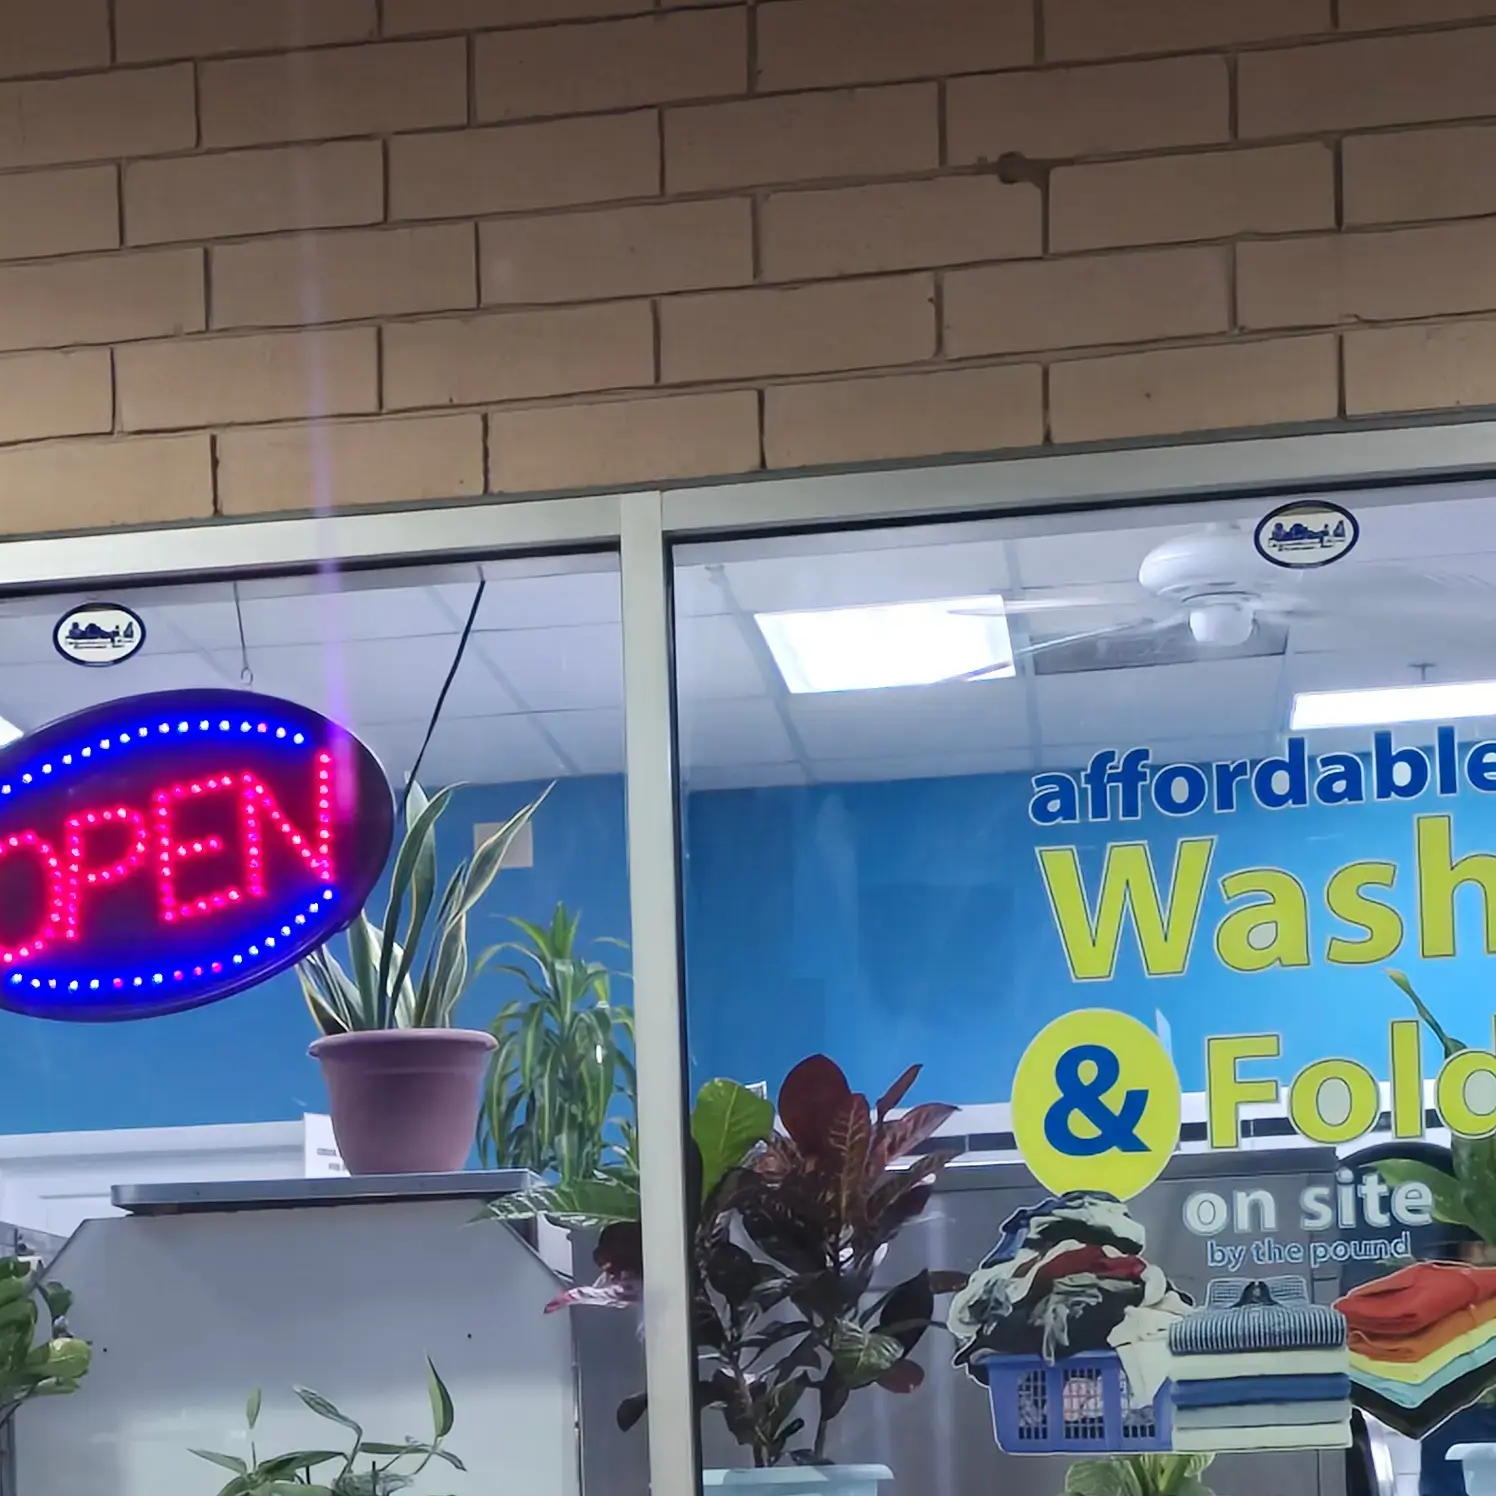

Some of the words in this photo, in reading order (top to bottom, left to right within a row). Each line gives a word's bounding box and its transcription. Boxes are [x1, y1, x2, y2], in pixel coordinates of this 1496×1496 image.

[1029, 725, 1496, 826] affordable
[1035, 813, 1496, 982] Wash
[1044, 1043, 1152, 1157] &
[1183, 1189, 1278, 1236] on
[1300, 1166, 1435, 1231] site
[1207, 1240, 1246, 1271] by
[1253, 1237, 1303, 1264] the
[1310, 1231, 1411, 1267] pound
